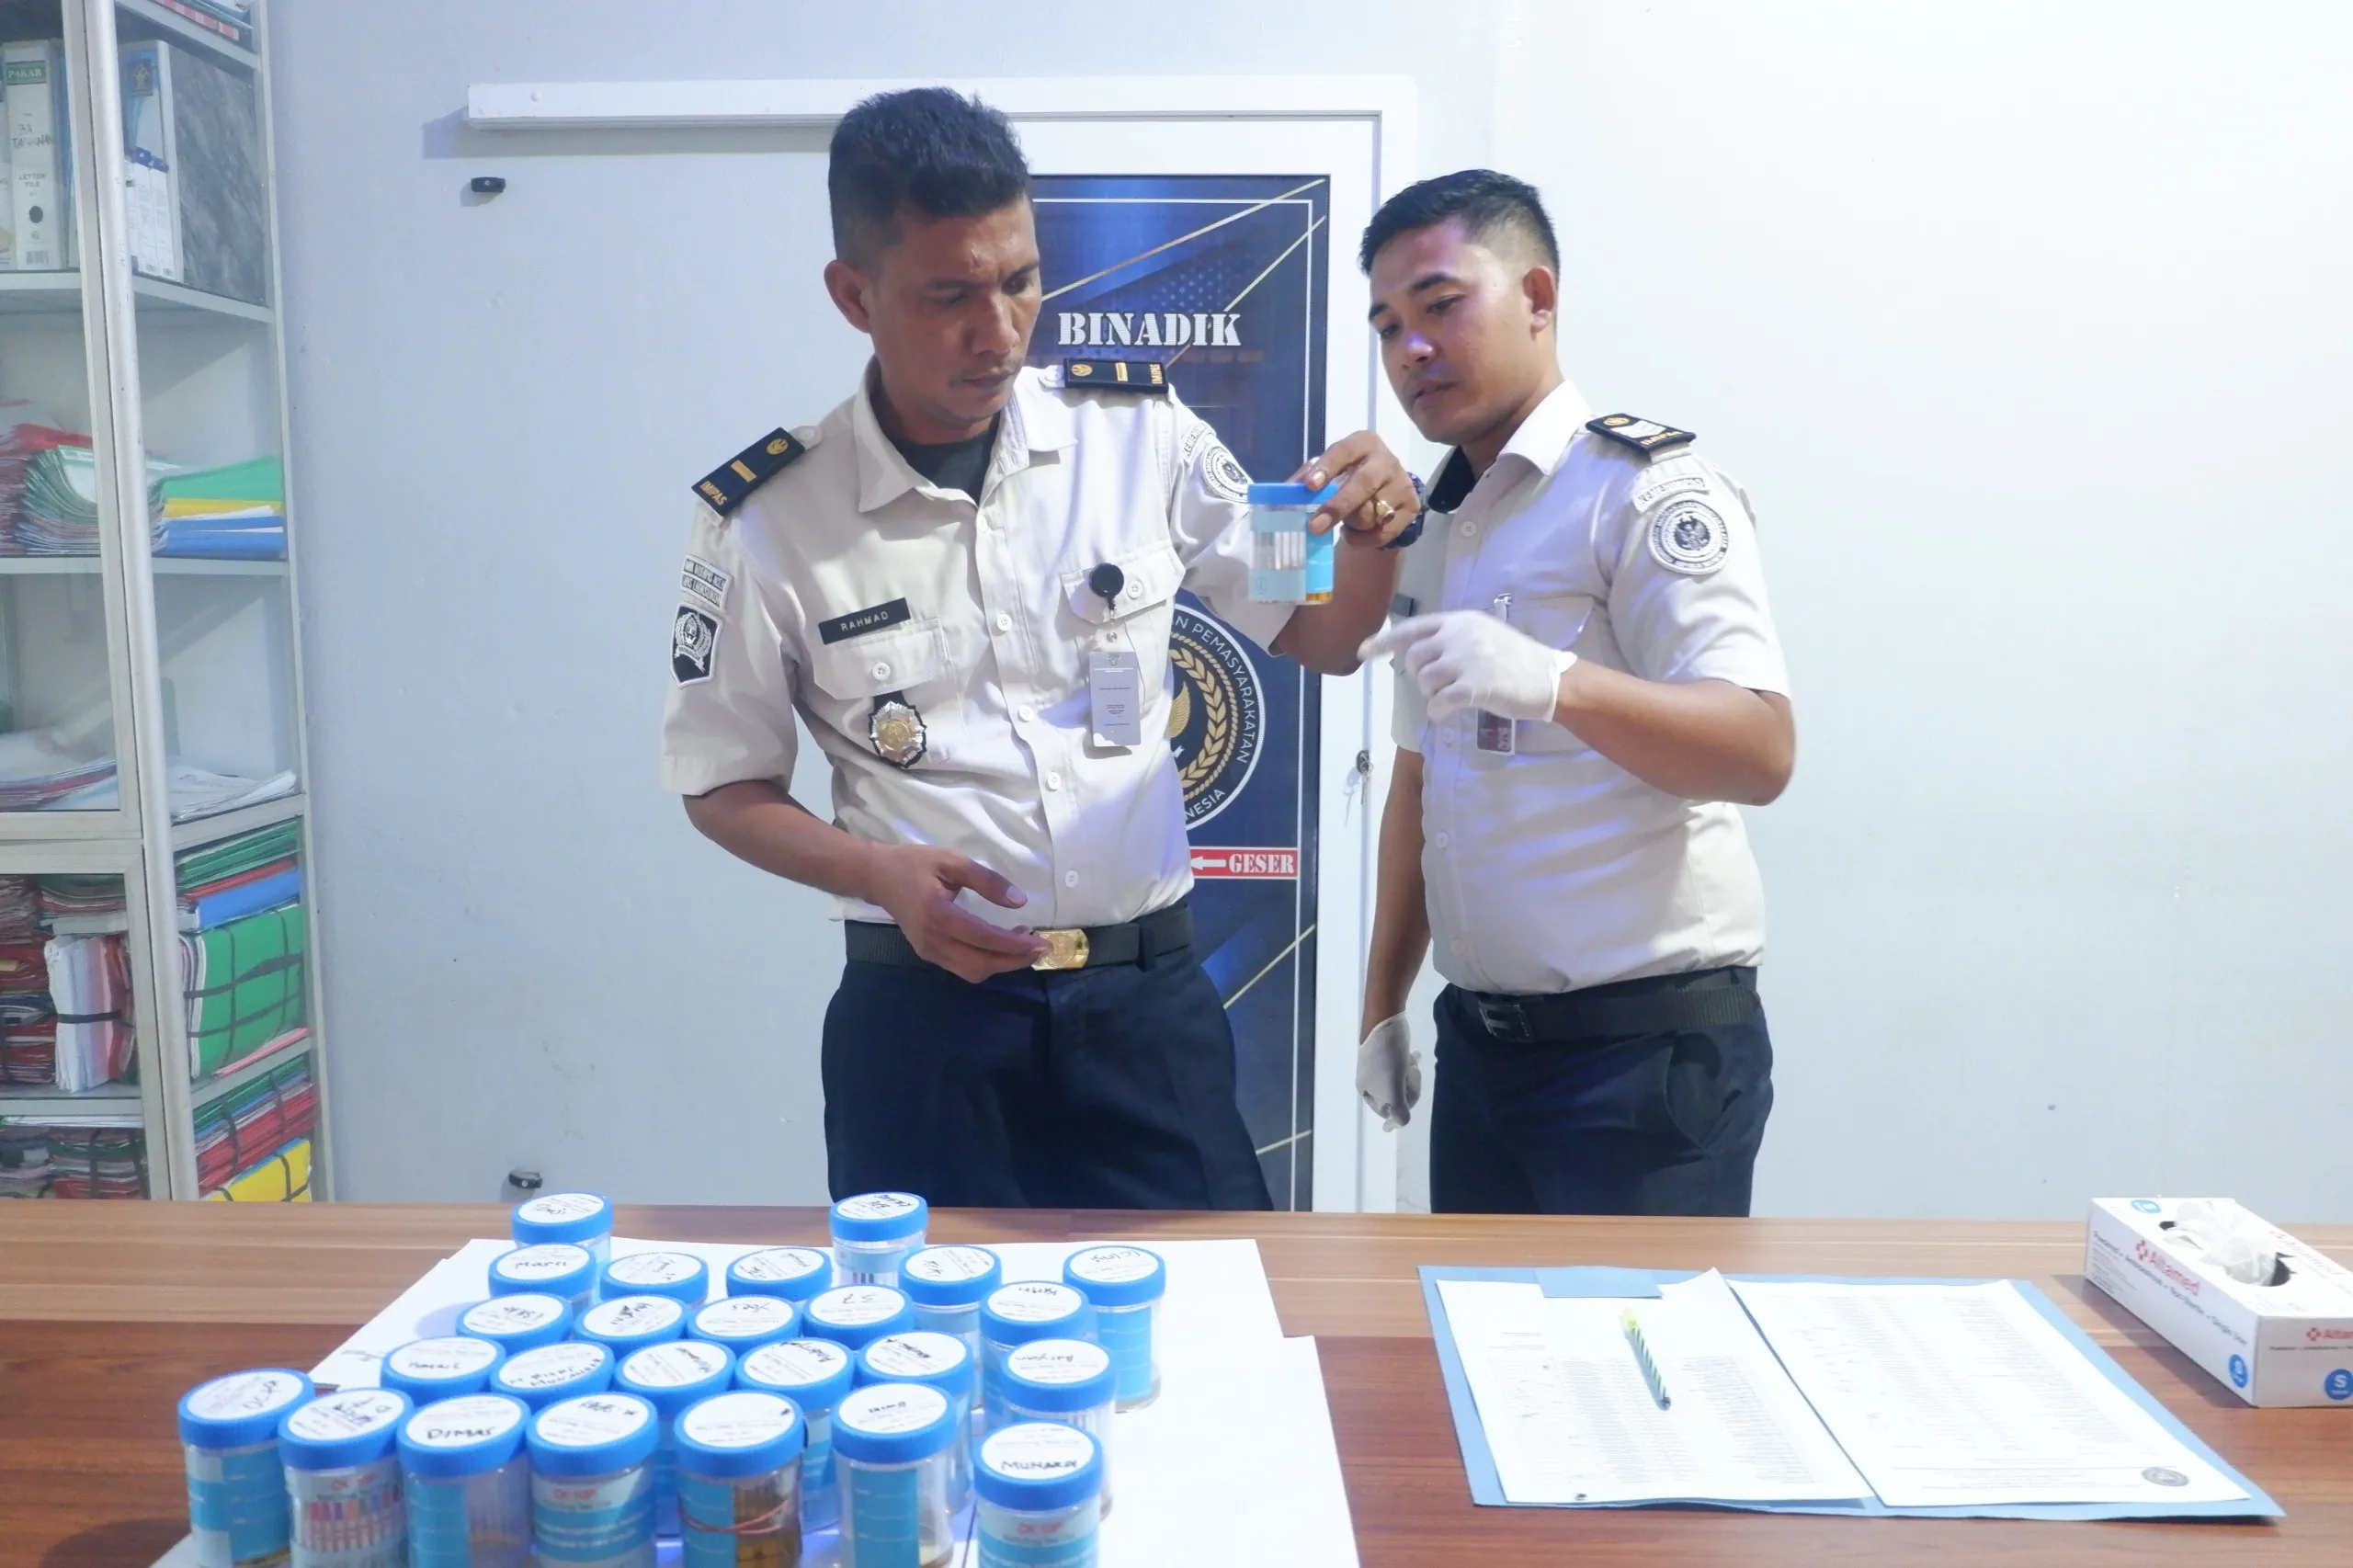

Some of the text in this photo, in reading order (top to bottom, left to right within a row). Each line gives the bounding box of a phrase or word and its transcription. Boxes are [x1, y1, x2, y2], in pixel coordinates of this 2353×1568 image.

[8, 68, 42, 80] PAKAR
[1058, 312, 1242, 347] BINADIK
[840, 610, 889, 632] RAHMAD
[1191, 623, 1255, 764] PEMASYARAKATAN
[1228, 853, 1295, 874] GESER
[2334, 1374, 2347, 1389] S
